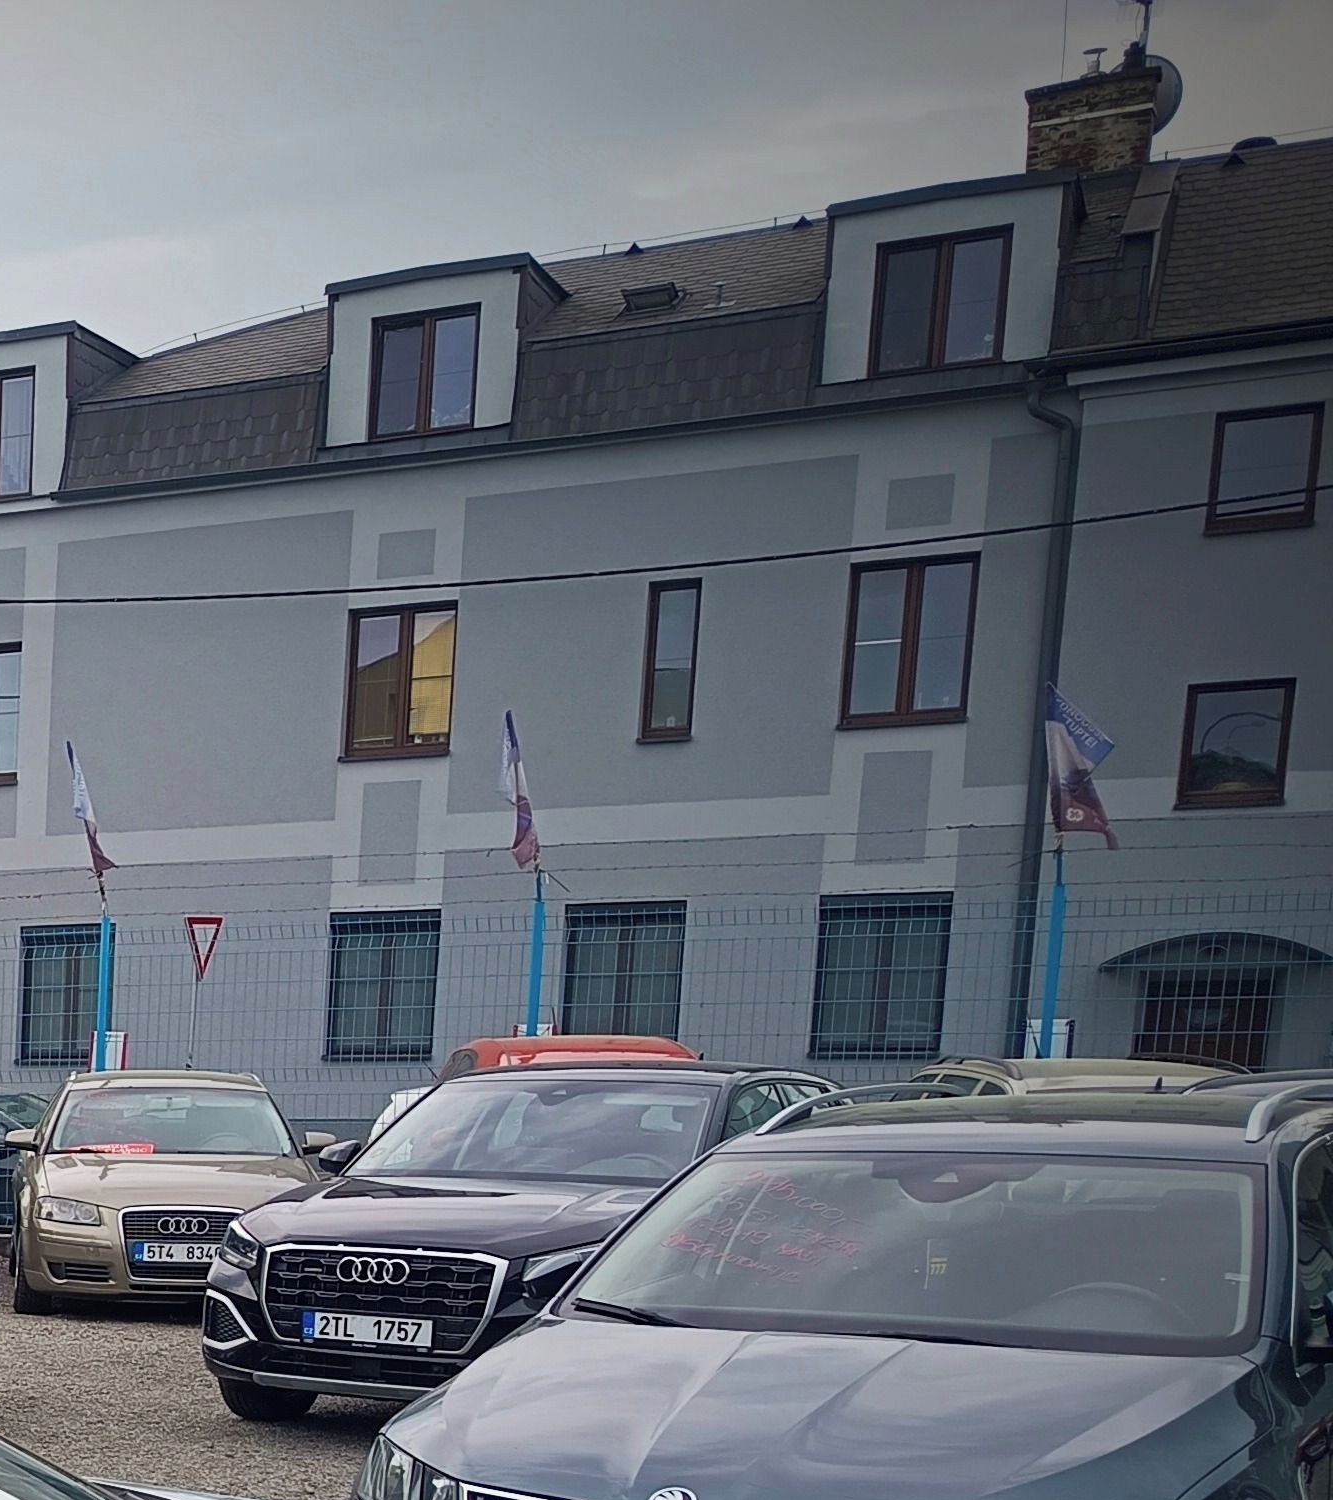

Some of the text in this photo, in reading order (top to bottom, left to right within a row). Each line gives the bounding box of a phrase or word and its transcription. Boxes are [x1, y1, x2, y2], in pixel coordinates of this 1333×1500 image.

[147, 1245, 174, 1260] 5T4
[319, 1315, 423, 1343] 2TL 1757
